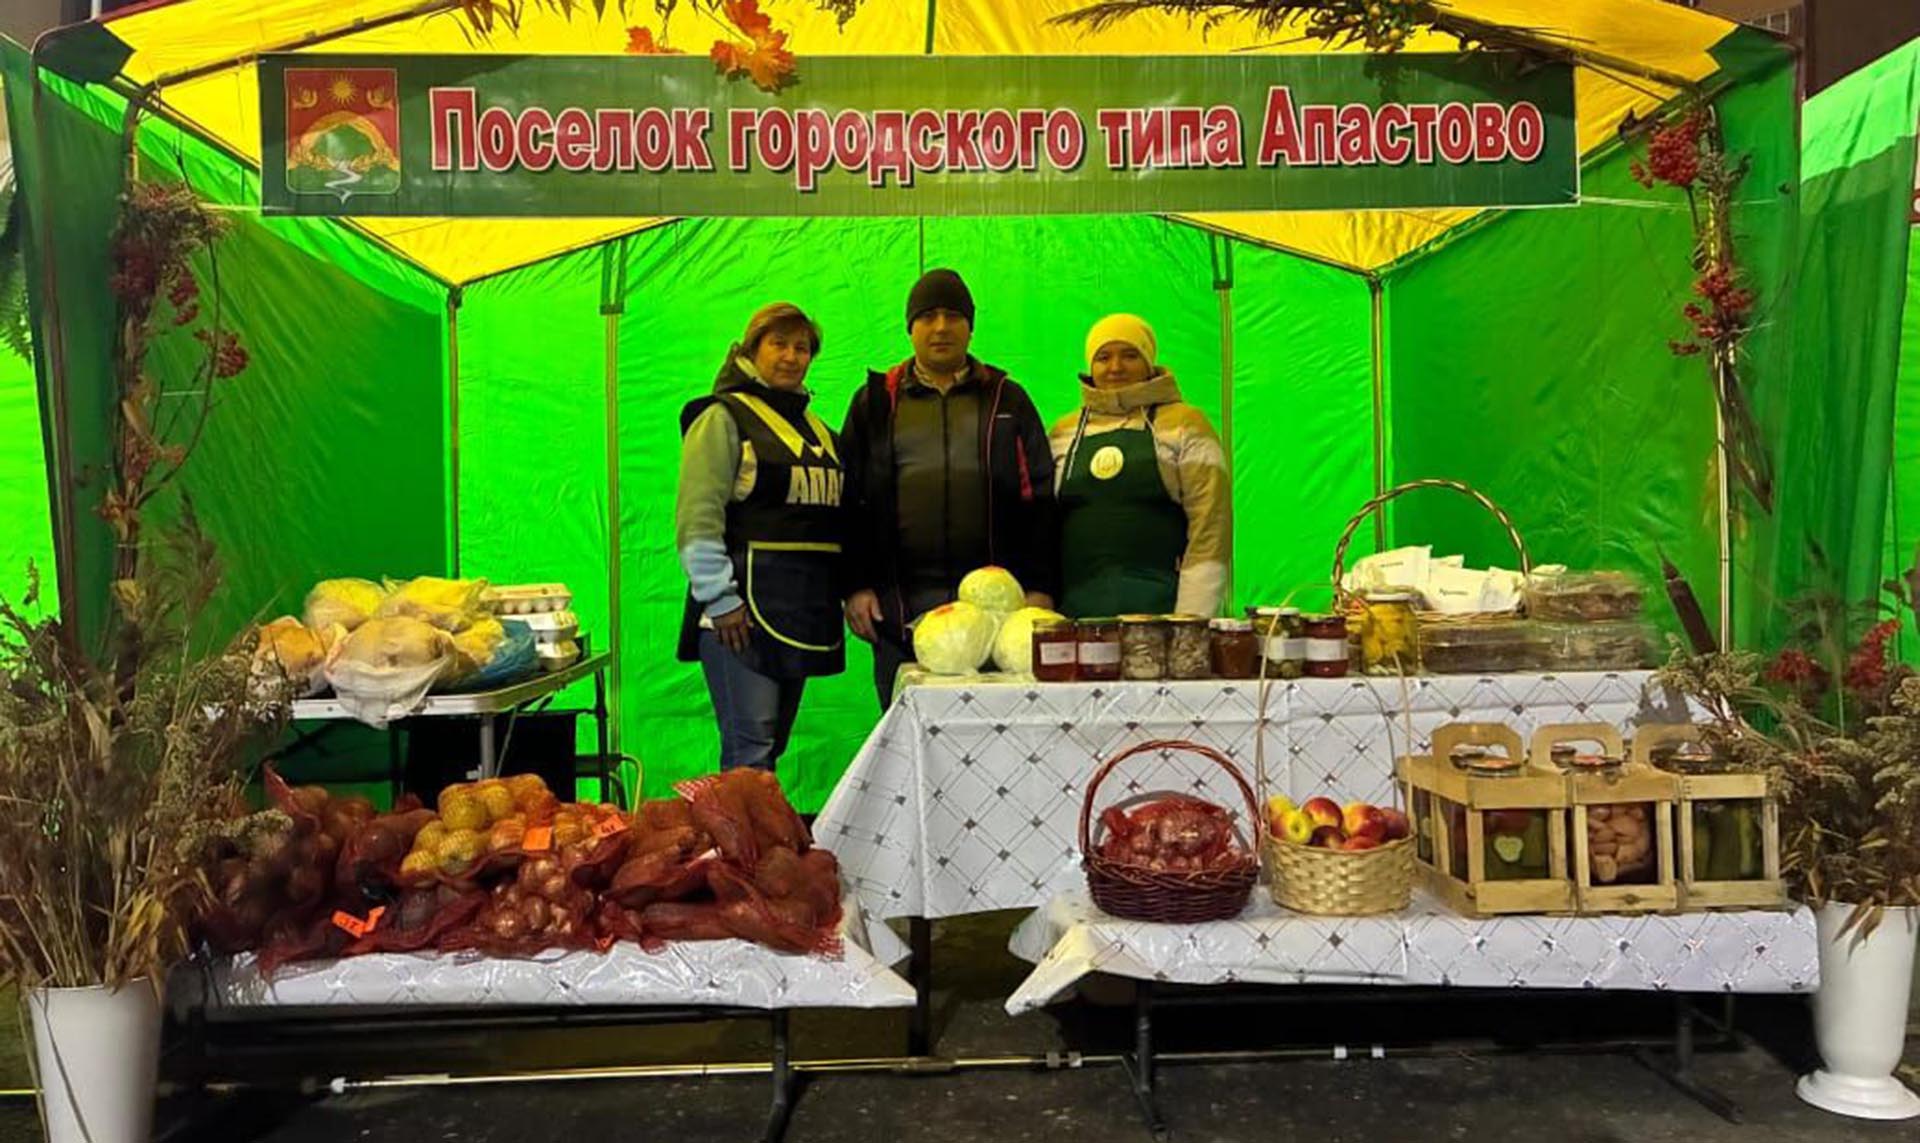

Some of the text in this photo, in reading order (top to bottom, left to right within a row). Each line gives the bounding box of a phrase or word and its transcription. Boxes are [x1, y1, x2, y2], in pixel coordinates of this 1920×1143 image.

[429, 86, 1543, 189] Поселок городского типа Апастово
[785, 465, 844, 506] АПА
